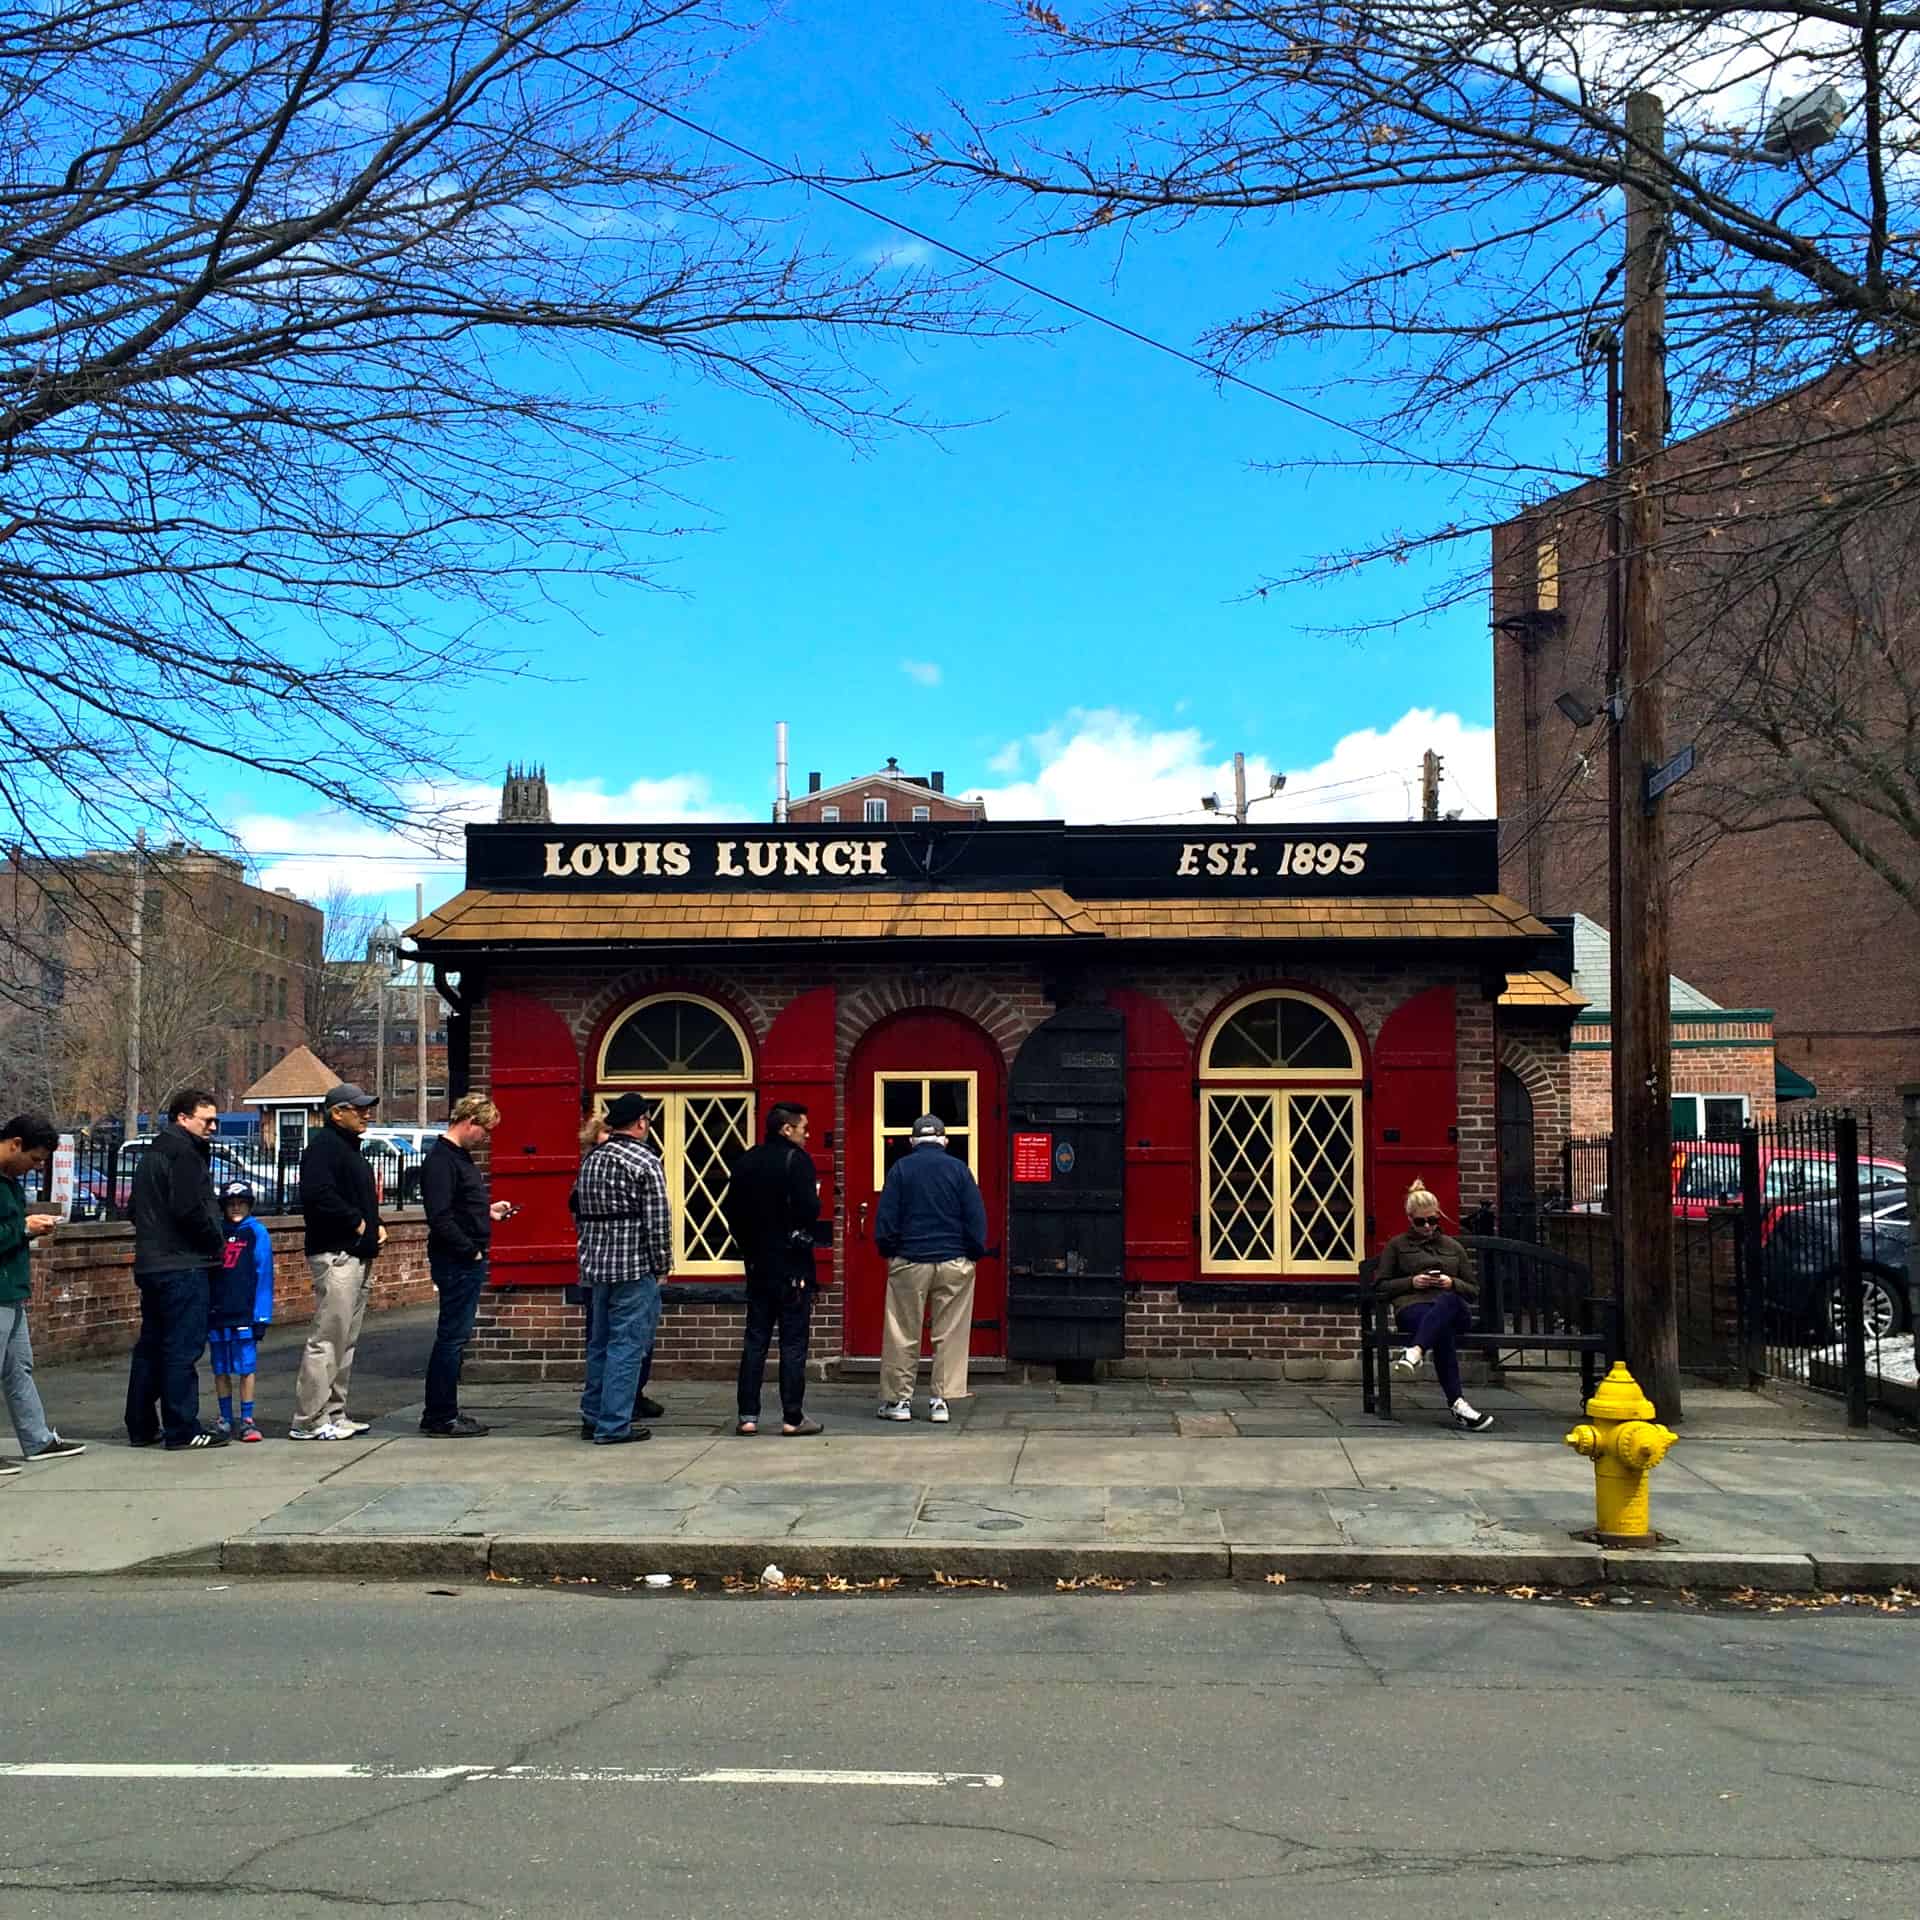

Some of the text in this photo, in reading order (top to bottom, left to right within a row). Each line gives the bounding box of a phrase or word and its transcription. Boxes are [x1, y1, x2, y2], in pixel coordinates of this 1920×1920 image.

[543, 841, 888, 877] LOUIS LUNCH
[1176, 842, 1368, 876] EST. 1895
